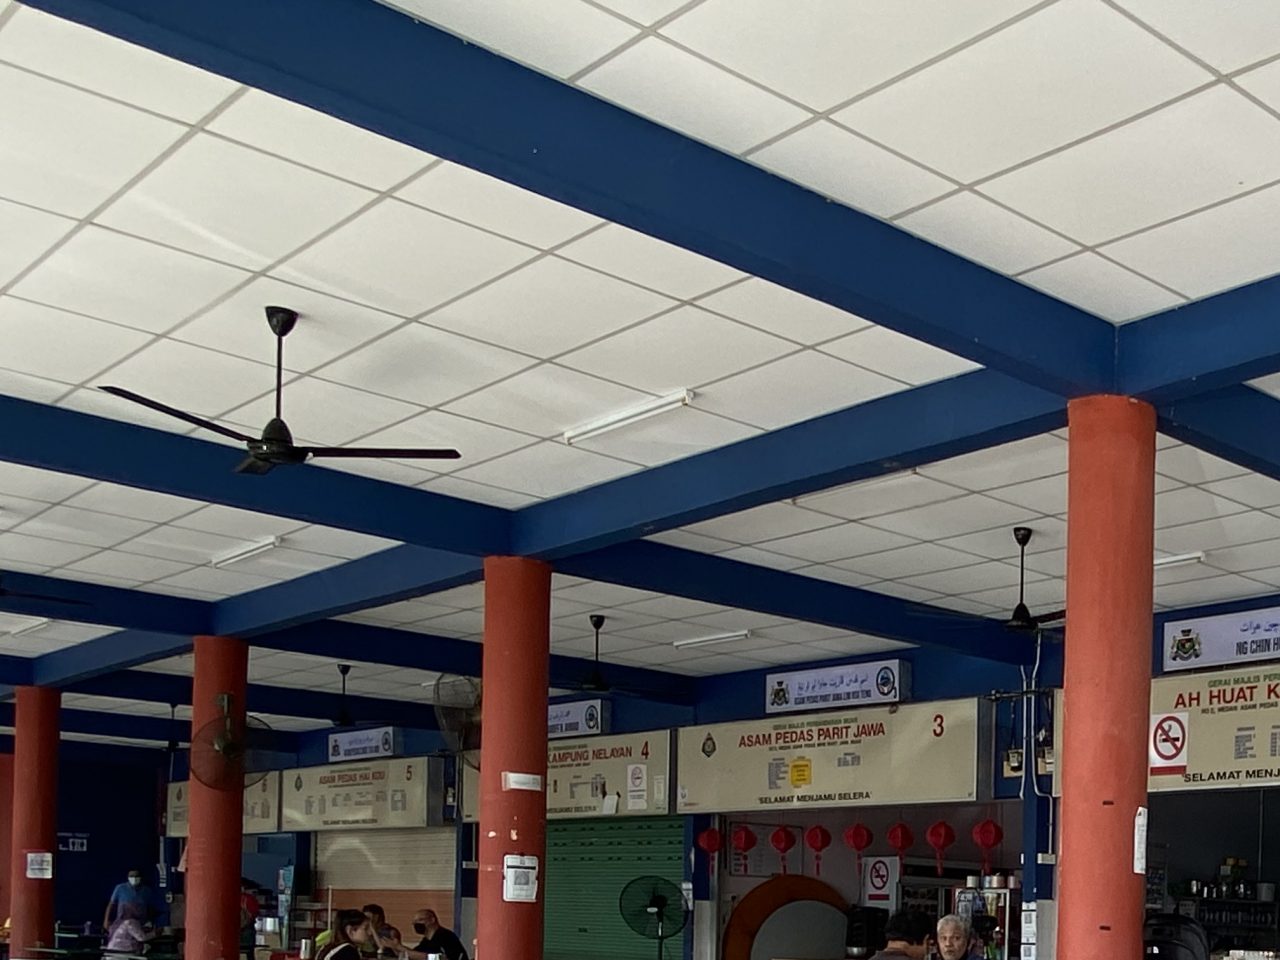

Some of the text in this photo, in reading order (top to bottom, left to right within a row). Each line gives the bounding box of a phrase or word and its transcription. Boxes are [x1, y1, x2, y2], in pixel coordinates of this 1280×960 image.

[1236, 641, 1248, 656] NG
[1250, 639, 1271, 654] CHIN
[1174, 691, 1201, 709] AH
[1209, 685, 1258, 706] HUAT
[739, 733, 772, 748] ASAM
[775, 729, 813, 745] PEDAS
[817, 725, 851, 741] PARIT
[853, 722, 885, 738] JAWA
[933, 714, 945, 737] 3
[592, 746, 632, 761] NELAYAN
[641, 741, 650, 760] 4
[406, 765, 413, 781] 5
